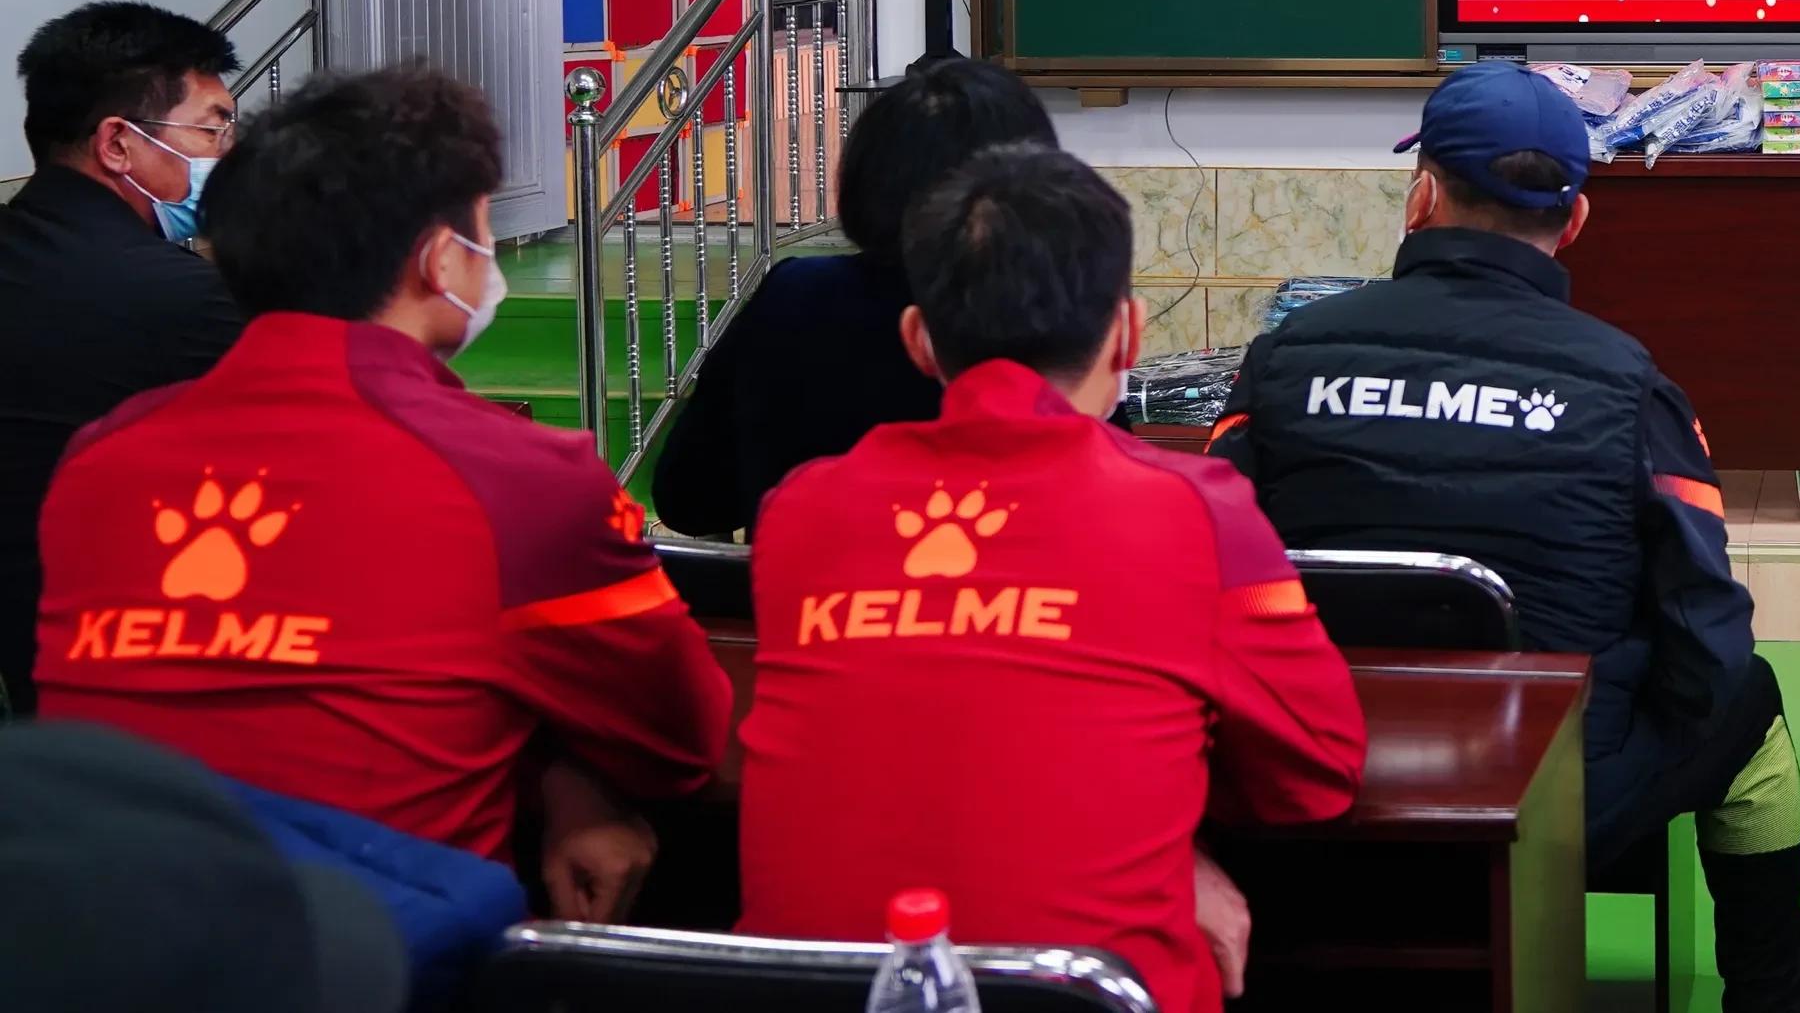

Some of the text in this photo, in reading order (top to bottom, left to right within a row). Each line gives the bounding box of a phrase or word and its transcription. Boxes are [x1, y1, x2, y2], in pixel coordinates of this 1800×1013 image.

[1307, 376, 1519, 428] KELME
[67, 609, 330, 664] KELME
[797, 587, 1079, 645] KELME
